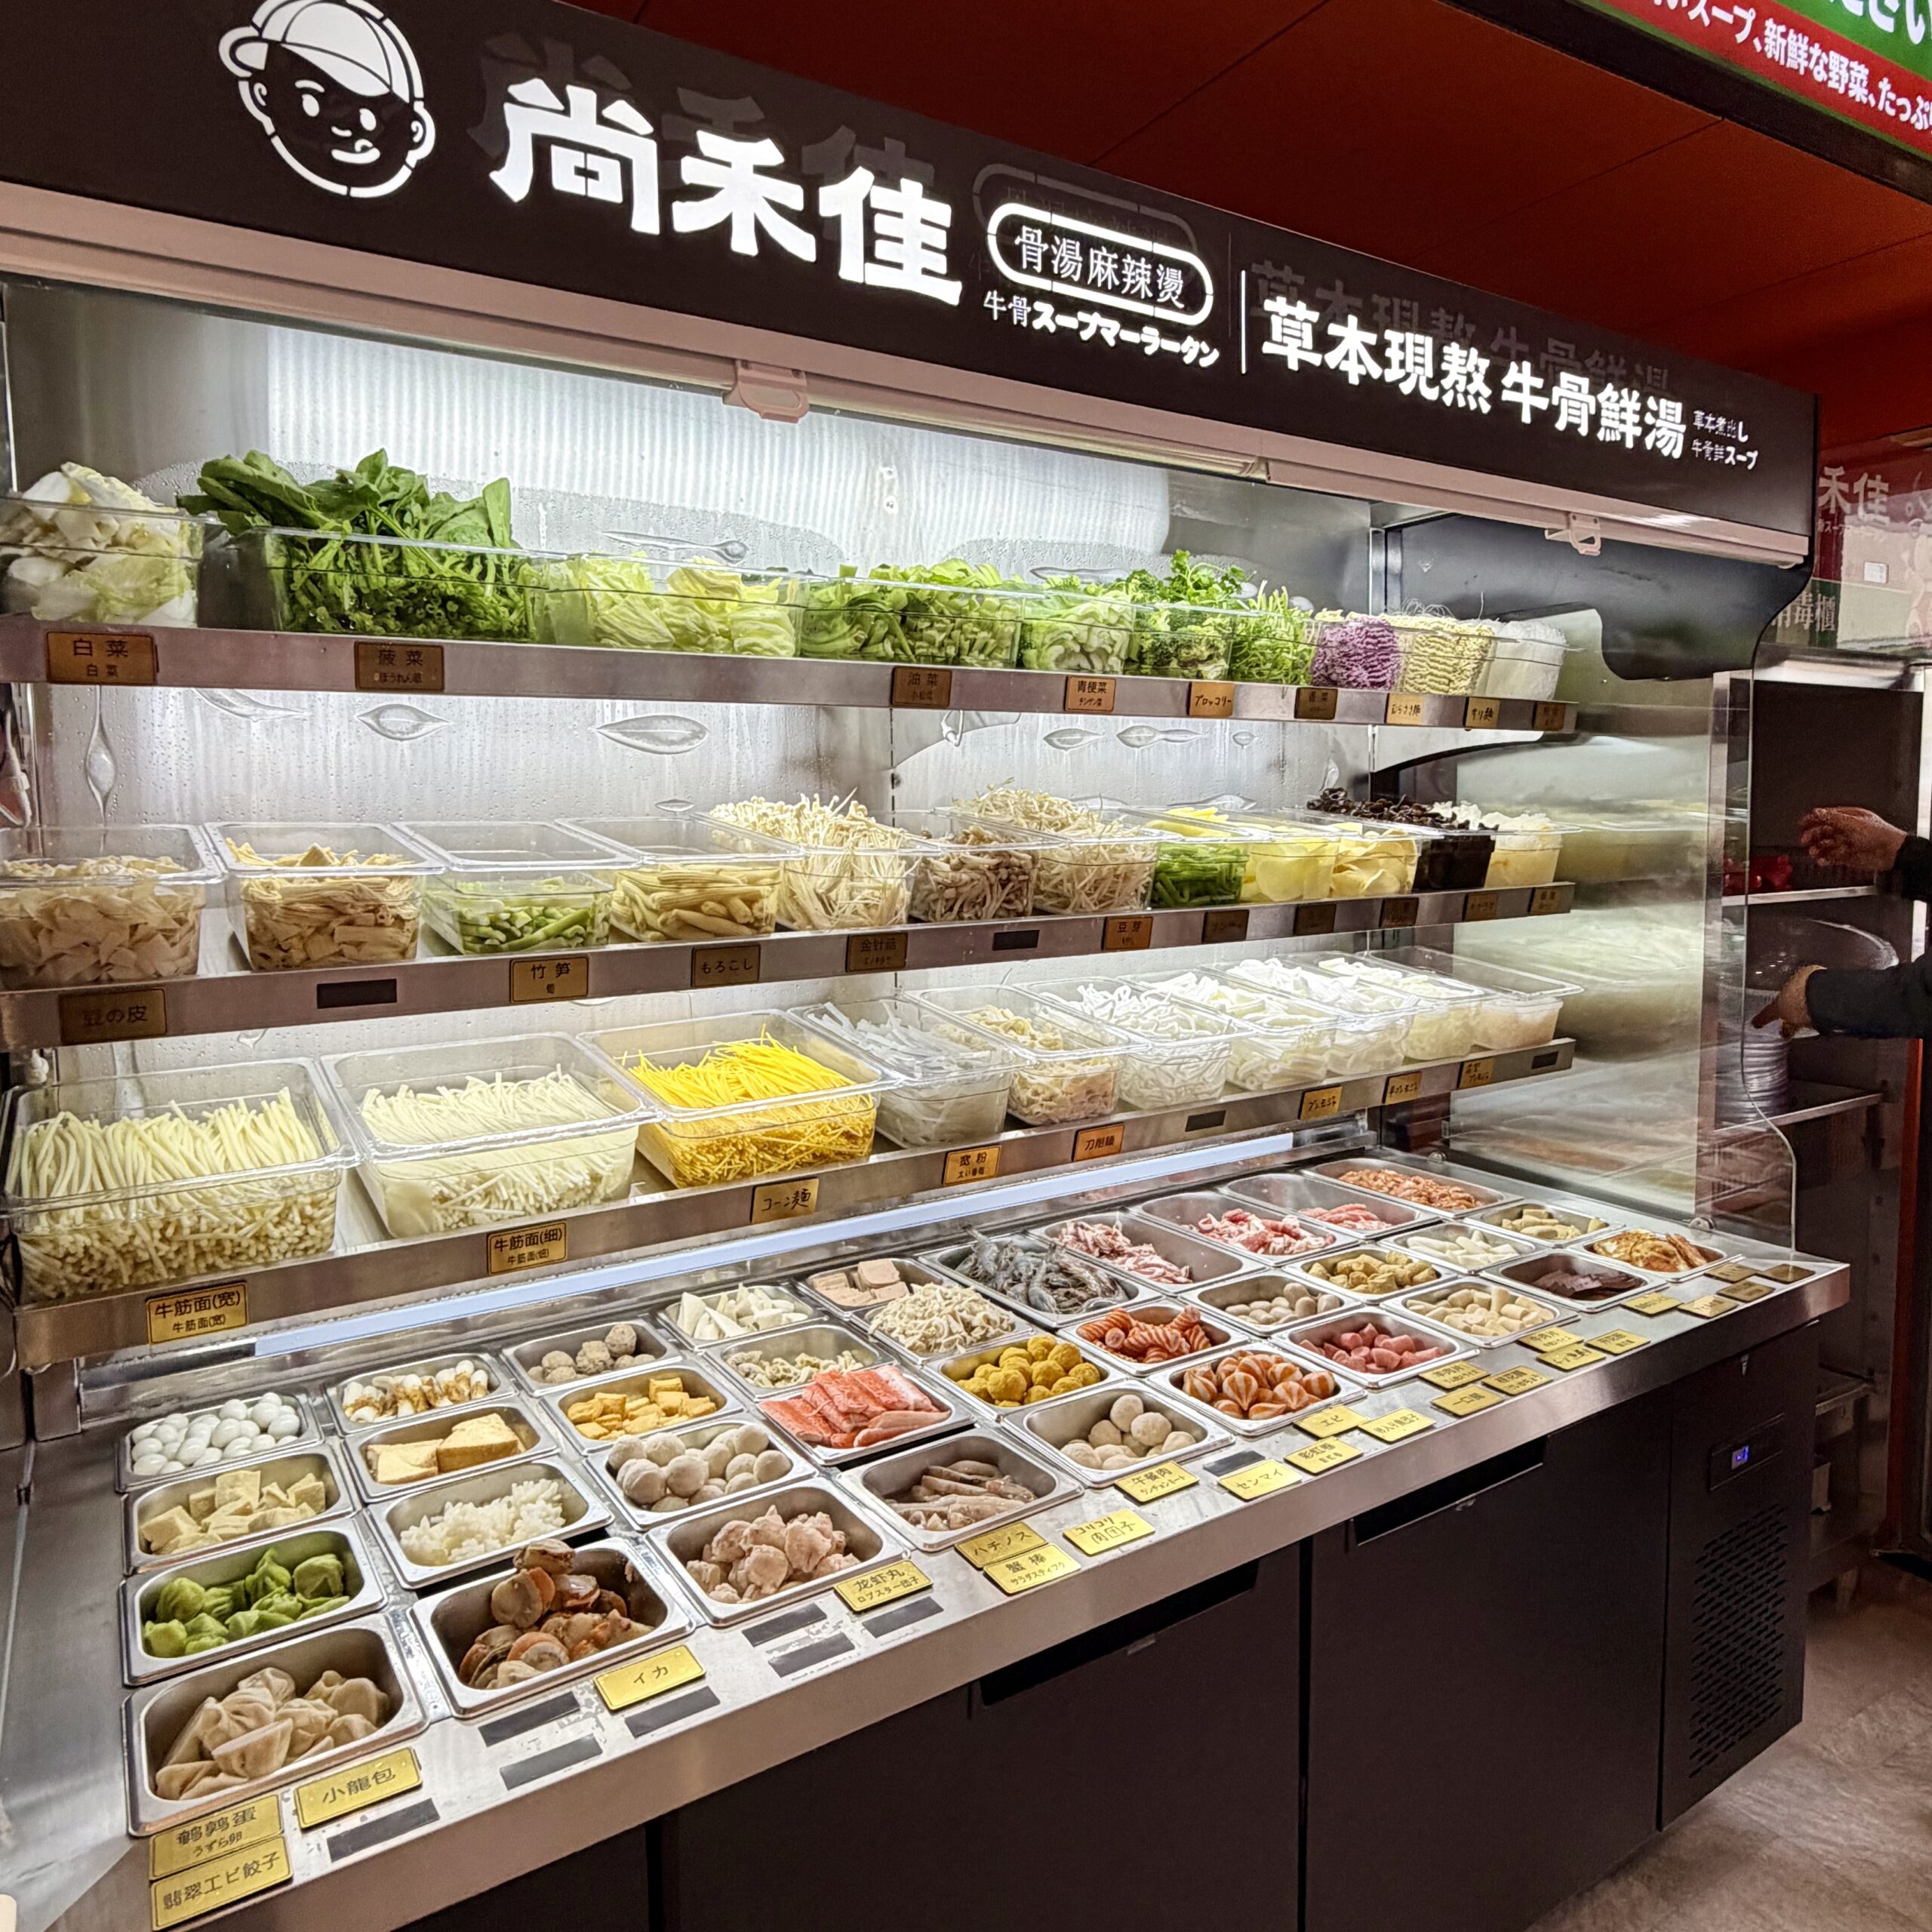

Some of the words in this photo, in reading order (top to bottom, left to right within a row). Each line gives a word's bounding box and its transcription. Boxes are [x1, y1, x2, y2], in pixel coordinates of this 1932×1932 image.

[489, 77, 963, 306] 尚禾佳
[1014, 225, 1185, 309] 骨湯麻辣燙
[983, 290, 1220, 368] 牛骨スープマーラータン
[73, 638, 128, 658] 白菜
[701, 958, 753, 974] もろこし
[154, 1290, 241, 1319] 牛筋面(宽)
[1235, 1468, 1283, 1490] センマイ
[1075, 1516, 1115, 1534] コリコリ
[974, 1531, 1032, 1556] ハチノス
[633, 1666, 669, 1684] イカ
[322, 1767, 396, 1804] 小龍包
[162, 1851, 280, 1910] 翡翠エビ餃子
